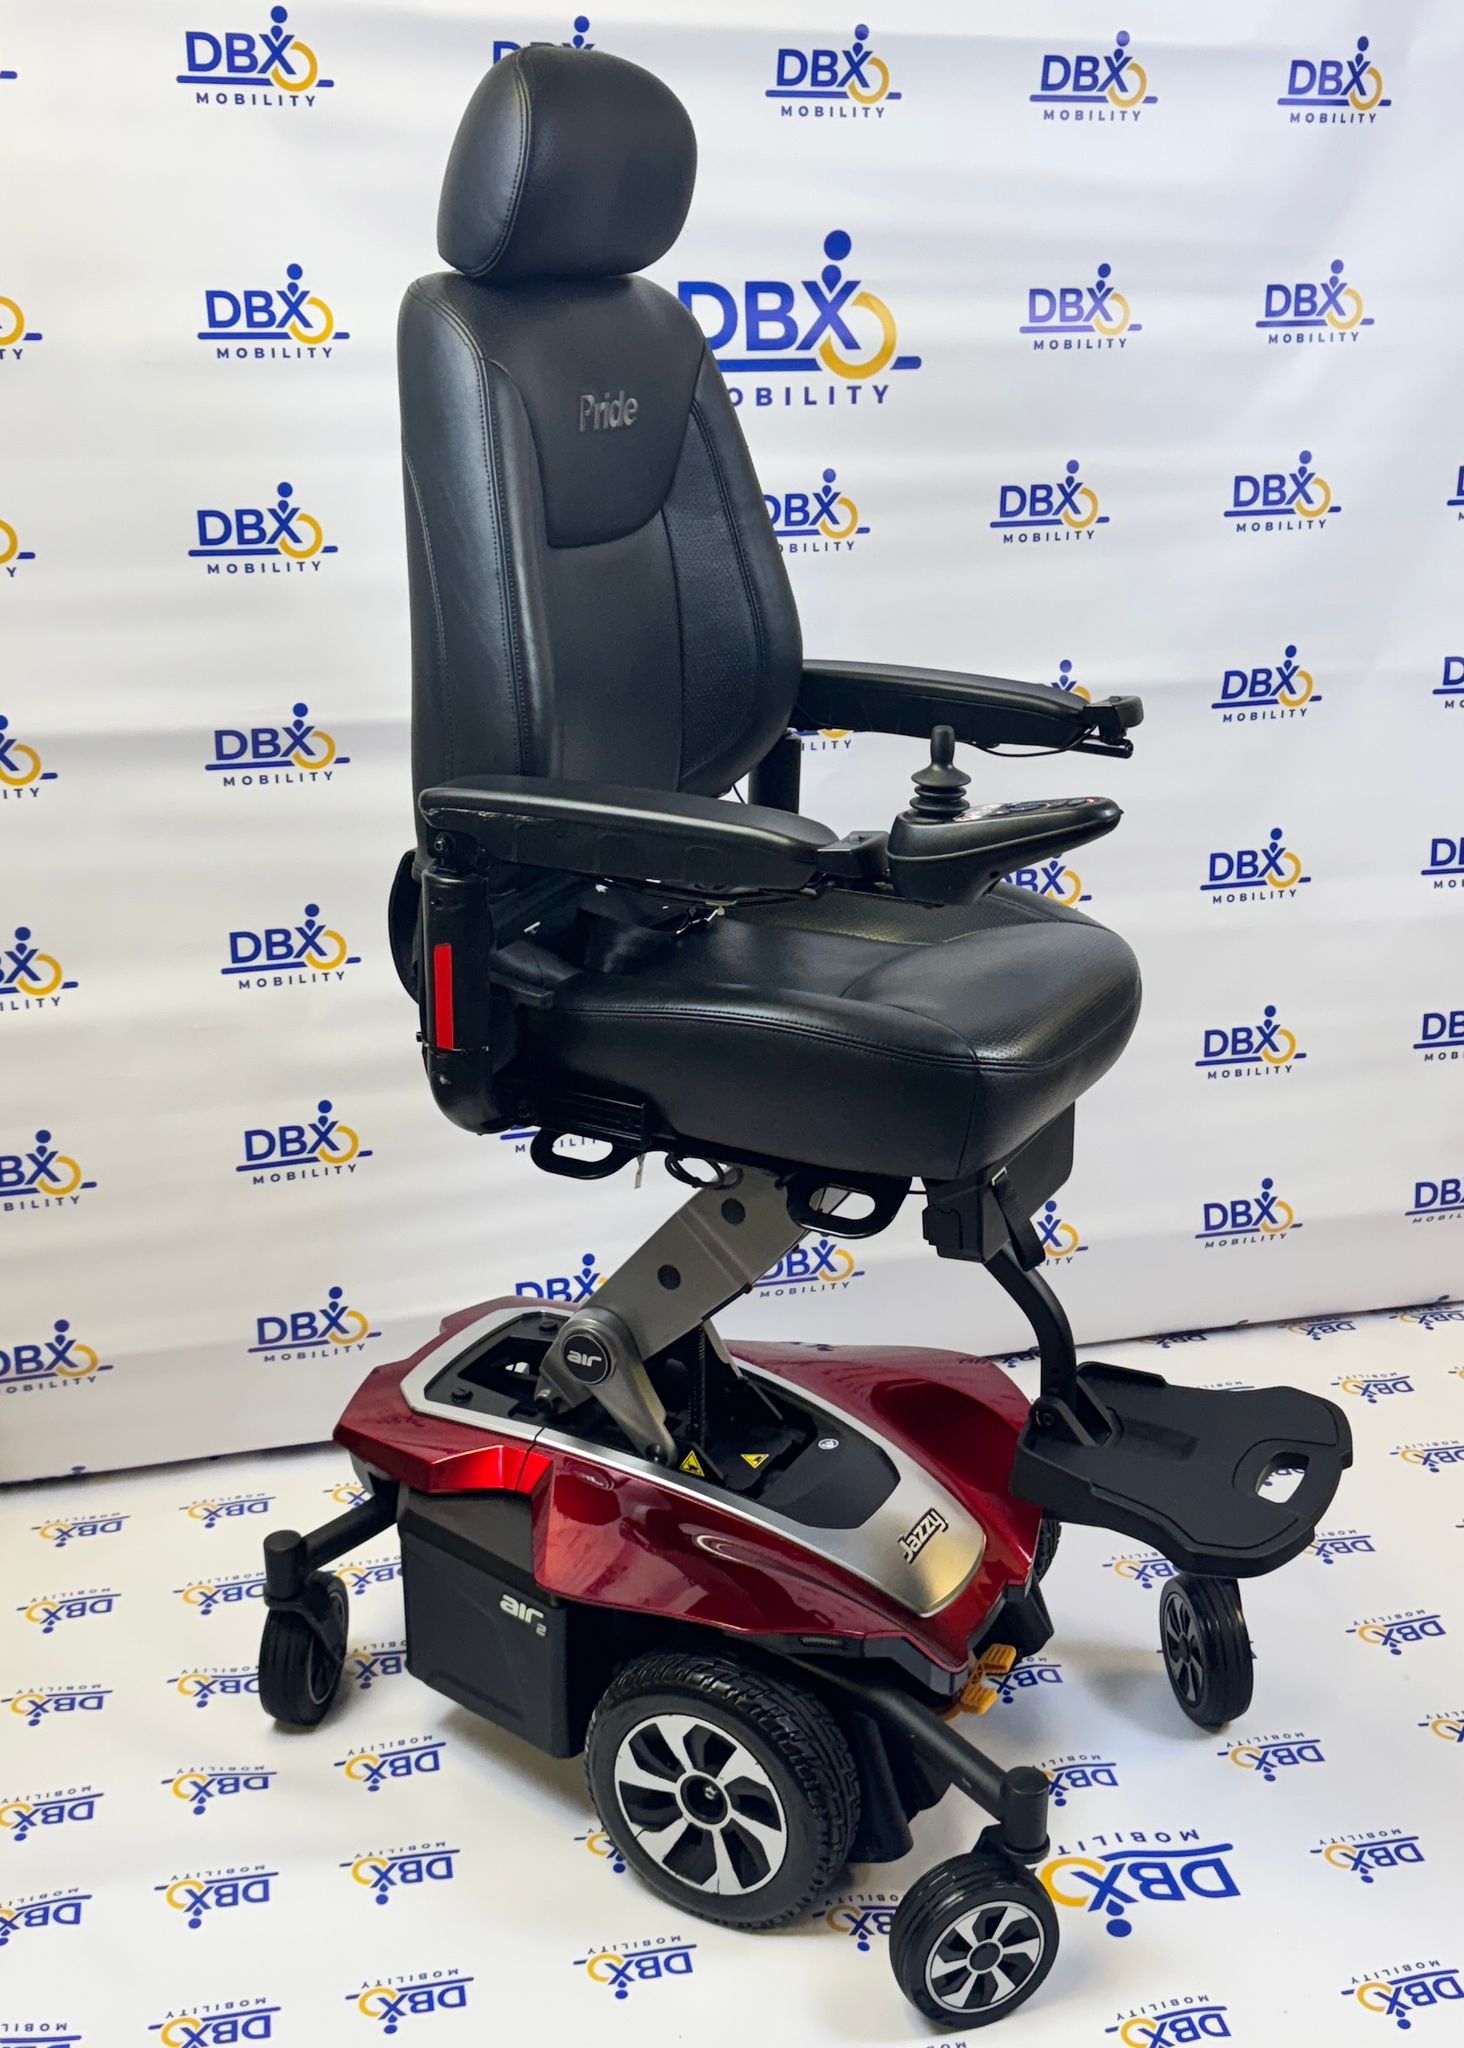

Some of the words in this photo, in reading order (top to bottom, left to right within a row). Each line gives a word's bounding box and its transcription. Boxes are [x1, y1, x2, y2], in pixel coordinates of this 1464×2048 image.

[186, 31, 296, 75] DBX
[777, 49, 872, 88] DBX
[1041, 55, 1132, 92] DBX
[1288, 59, 1371, 97] DBX
[196, 93, 315, 106] MOBILITY
[781, 106, 884, 118] MOBILITY
[1044, 110, 1140, 121] MOBILITY
[1290, 113, 1376, 123] MOBILITY
[206, 290, 311, 329] DBX
[1029, 288, 1114, 322] DBX
[1265, 283, 1346, 317] DBX
[678, 281, 861, 351] DBX
[1034, 339, 1126, 350] MOBILITY
[1269, 332, 1358, 344] MOBILITY
[217, 348, 331, 358] MOBILITY
[728, 385, 888, 406] OBILITY
[580, 390, 639, 432] Pride
[1000, 483, 1082, 517] DBX
[1234, 473, 1315, 507] DBX
[197, 508, 302, 546] DBX
[1004, 530, 1094, 543] MOBILITY
[1237, 520, 1326, 532] MOBILITY
[778, 541, 854, 553] BILITY
[208, 561, 320, 574] MOBILITY
[1221, 666, 1299, 699] DBX
[1223, 709, 1306, 722] MOBILITY
[215, 726, 315, 760] DBX
[801, 740, 851, 751] ILITY
[224, 771, 332, 786] MOBILITY
[1210, 848, 1285, 881] DBX
[1004, 866, 1066, 895] BX
[1213, 889, 1296, 903] MOBILITY
[230, 925, 327, 963] DBX
[239, 972, 344, 989] MOBILITY
[0, 997, 60, 1011] ILITY
[1422, 1011, 1464, 1041] DB
[1204, 1025, 1280, 1057] DBX
[1208, 1065, 1292, 1079] MOBILITY
[245, 1120, 338, 1162] DBX
[0, 1151, 61, 1187] BX
[253, 1164, 355, 1184] MOBILITY
[4, 1195, 79, 1211] BILITY
[1414, 1178, 1464, 1209] DB
[1204, 1197, 1277, 1231] DBX
[1412, 1212, 1464, 1223] MOBIL
[1205, 1233, 1286, 1248] MOBILITY
[760, 1282, 850, 1297] MOBILITY
[257, 1306, 348, 1345] DBX
[263, 1343, 365, 1362] MOBILITY
[567, 1350, 602, 1367] air
[1, 1377, 96, 1394] OBILITY
[898, 1507, 949, 1565] Jazzy
[339, 1555, 401, 1568] OBILITY
[1111, 1551, 1159, 1561] BILITY
[351, 1567, 402, 1588] BX
[1128, 1562, 1176, 1580] BX
[40, 1598, 113, 1624] DBX
[500, 1594, 544, 1624] air
[536, 1623, 547, 1637] 2
[1353, 1609, 1426, 1626] MOBILITY
[1372, 1620, 1447, 1646] DBX
[181, 1666, 260, 1675] OBILITY
[355, 1656, 404, 1680] BX
[26, 1695, 104, 1717] DBX
[348, 1735, 433, 1755] MOBILITY
[1226, 1732, 1304, 1748] MOBILITY
[363, 1750, 440, 1782] DBX
[1032, 1755, 1102, 1769] MOBILI
[1245, 1745, 1326, 1770] DBX
[189, 1776, 270, 1802] DBX
[11, 1800, 95, 1829] DBX
[1058, 1829, 1200, 1856] MOBILIT
[1319, 1829, 1402, 1846] MOBILITY
[355, 1842, 446, 1859] MOBILITY
[1339, 1843, 1426, 1871] DBX
[171, 1865, 265, 1881] MOBILITY
[370, 1856, 454, 1888] DBX
[184, 1879, 270, 1912] DBX
[1070, 1858, 1241, 1912] DBX
[0, 1887, 79, 1908] MOBILI
[825, 1894, 899, 1906] OBILITY
[842, 1912, 894, 1936] BX
[587, 1935, 682, 1955] MOBILITY
[361, 1968, 460, 1990] MOBILITY
[605, 1951, 694, 1985] DBX
[1351, 1960, 1441, 1984] MOBILITY
[166, 1997, 267, 2019] MOBILITY
[377, 1985, 468, 2020] DBX
[1117, 1994, 1210, 2021] MOBILITY
[2, 2022, 67, 2032] MOBIL
